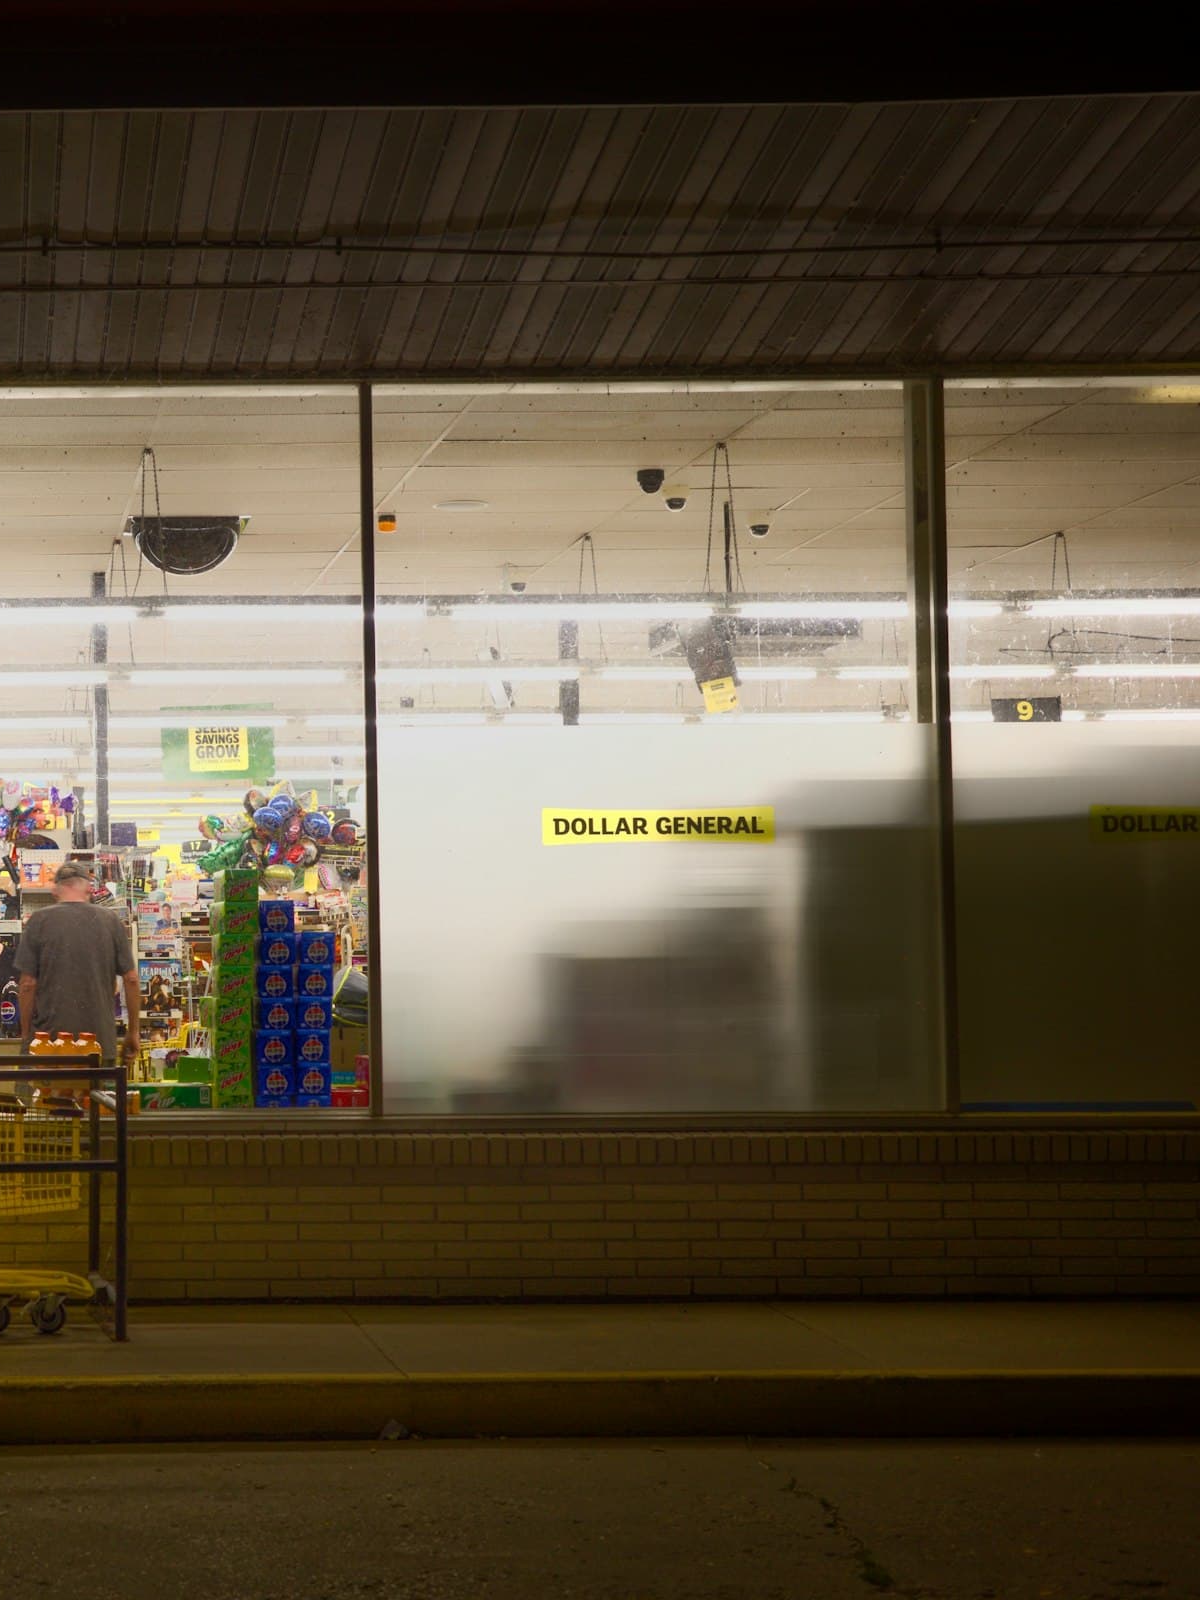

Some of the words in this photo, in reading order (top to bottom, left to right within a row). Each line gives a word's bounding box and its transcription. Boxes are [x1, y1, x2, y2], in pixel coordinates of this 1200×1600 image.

[1016, 701, 1033, 720] 9
[195, 734, 240, 745] SAVINGS
[553, 817, 648, 835] DOLLAR
[656, 816, 764, 834] GENERAL
[1101, 814, 1199, 833] DOLLAR
[189, 841, 202, 851] 17
[141, 967, 162, 977] PEARL
